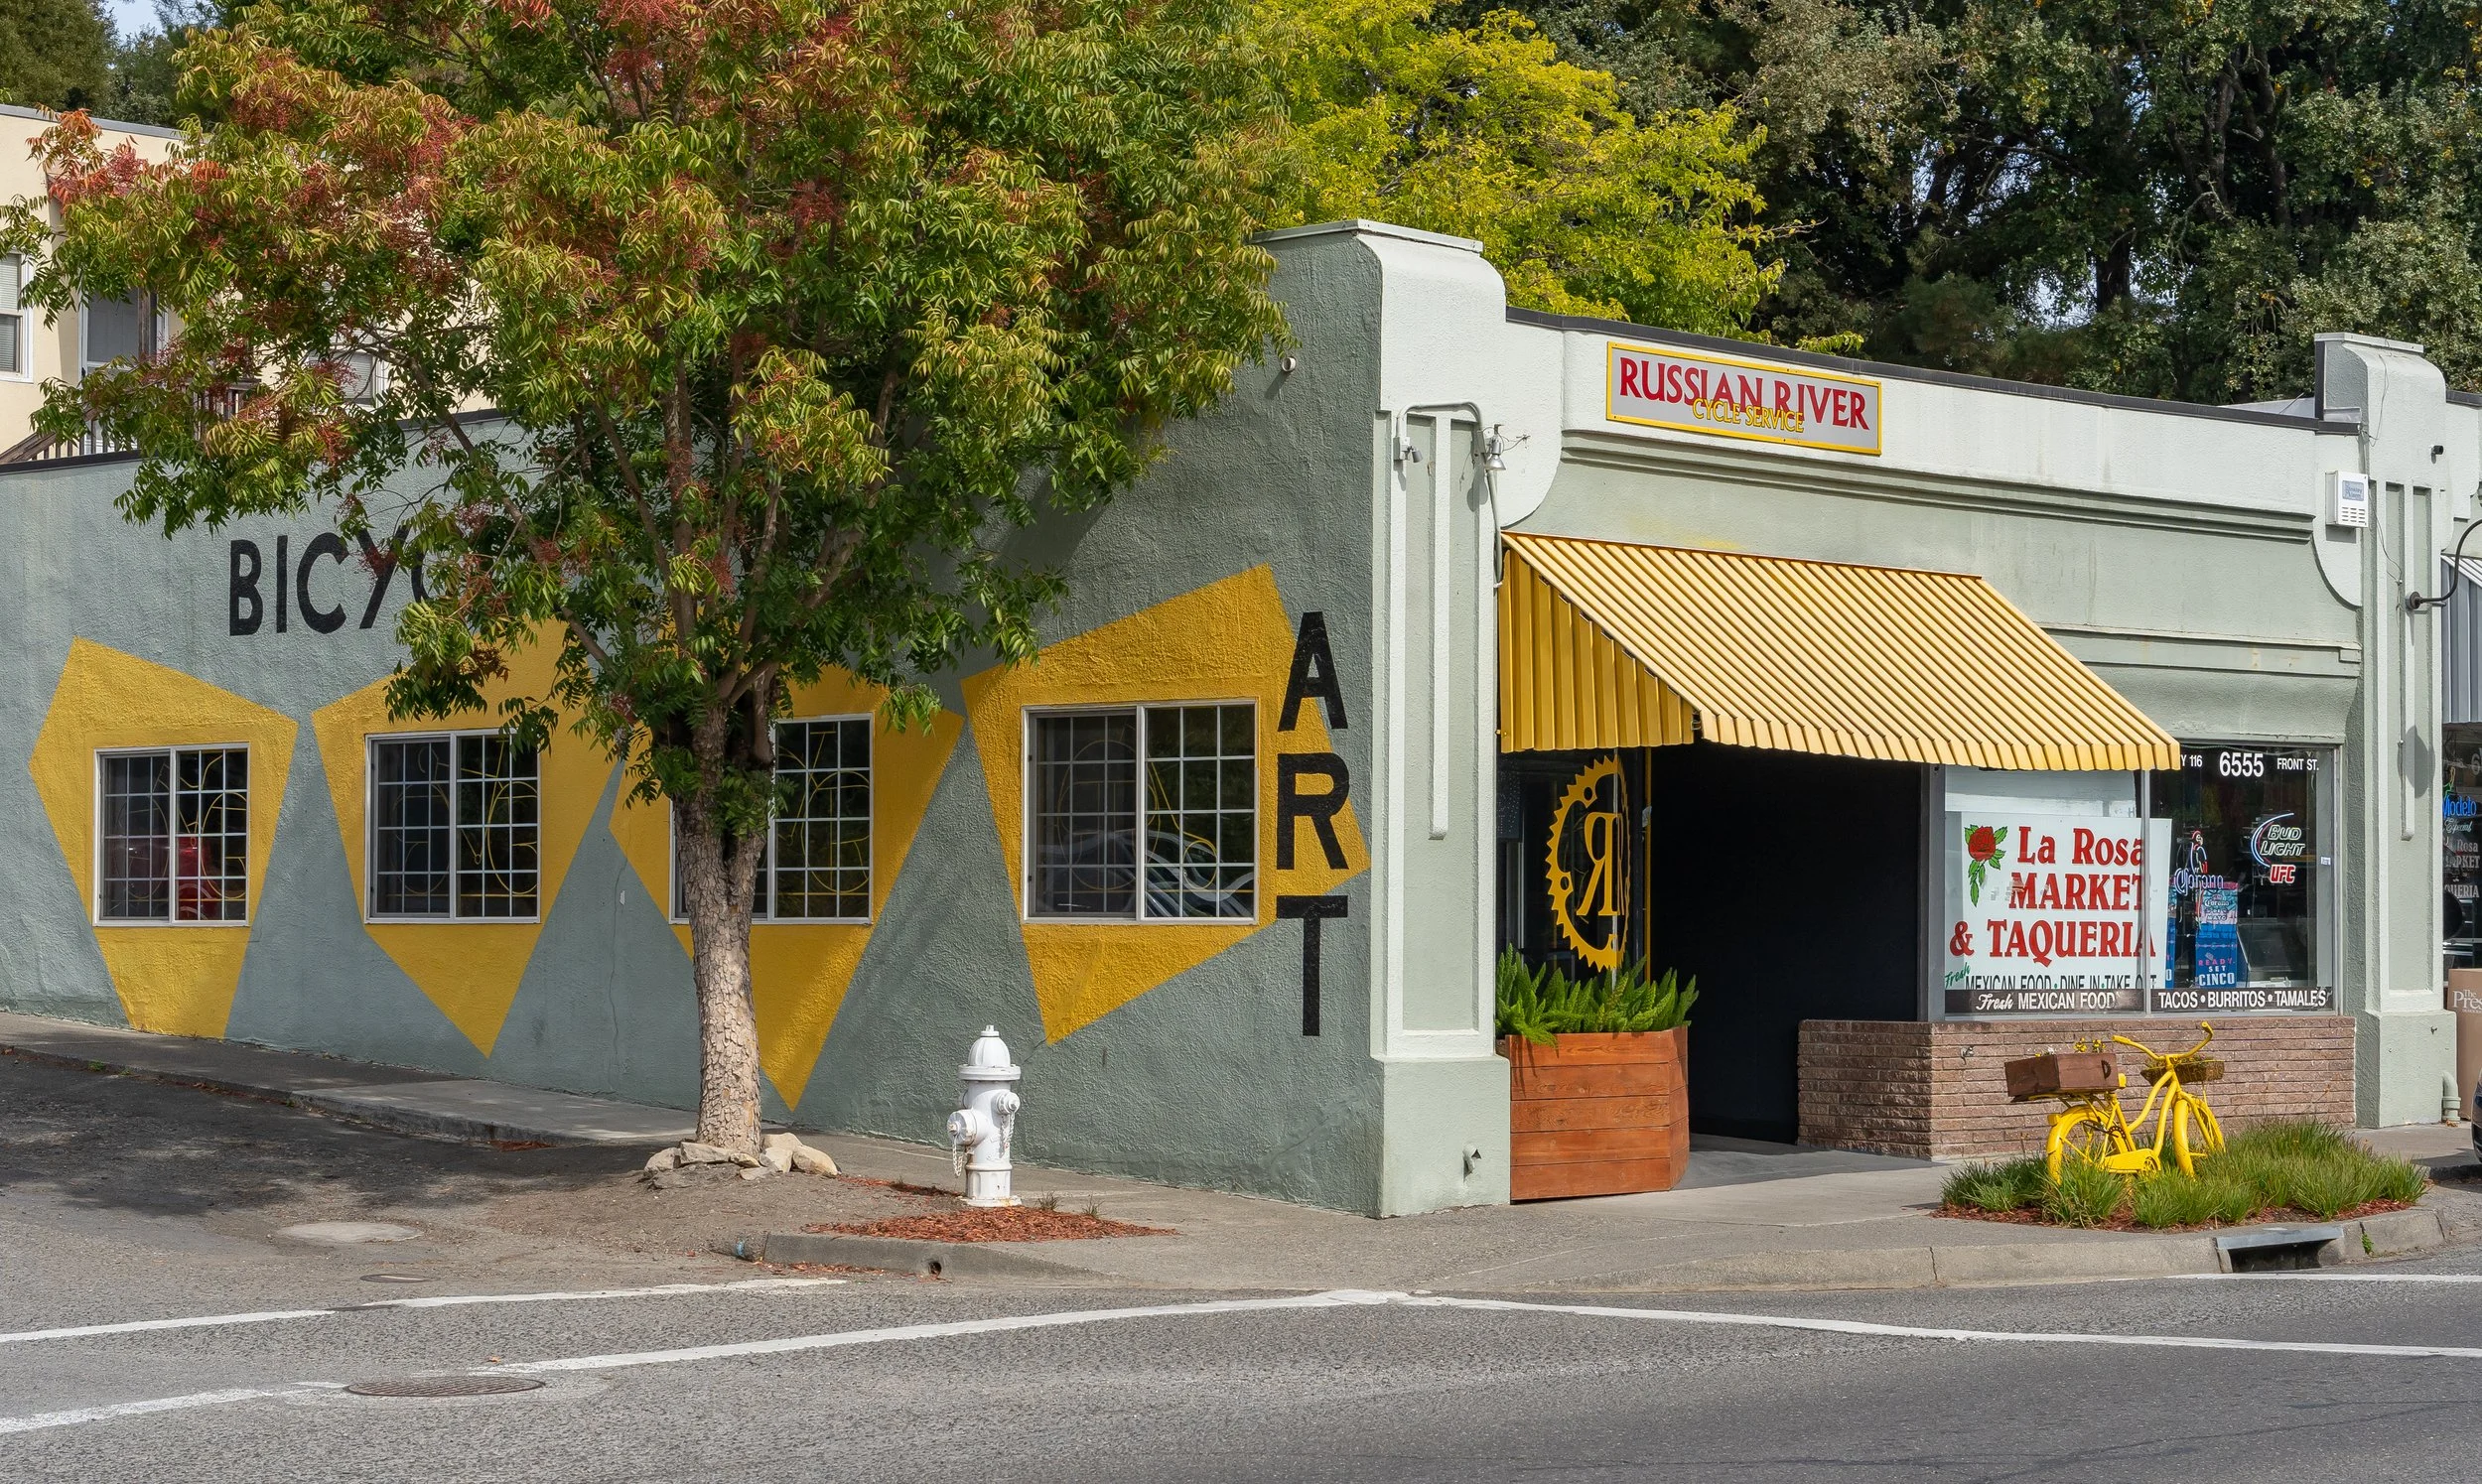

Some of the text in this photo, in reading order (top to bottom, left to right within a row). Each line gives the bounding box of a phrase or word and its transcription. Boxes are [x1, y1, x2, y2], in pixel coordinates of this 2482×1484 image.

[1620, 356, 1870, 431] RUSSIAN RIVER
[1693, 397, 1805, 434] CYCLE SERVICE
[2189, 754, 2203, 767] 116
[2219, 751, 2265, 777] 6555
[2276, 757, 2304, 771] FRONT
[2306, 758, 2320, 771] ST.
[1276, 611, 1350, 1036] ART
[2268, 824, 2302, 841] BUD
[2017, 826, 2055, 865] La
[2260, 840, 2305, 856] LIGHT
[2174, 868, 2224, 896] Corona
[2270, 865, 2296, 884] UFC
[1949, 919, 2156, 967] & TAQUERIA
[2198, 973, 2235, 987] CINCO
[1976, 992, 2117, 1012] Fresh MEXICAN FOOD
[2158, 990, 2327, 1009] TACOS BURRITOS TAMALES
[2463, 989, 2477, 998] The
